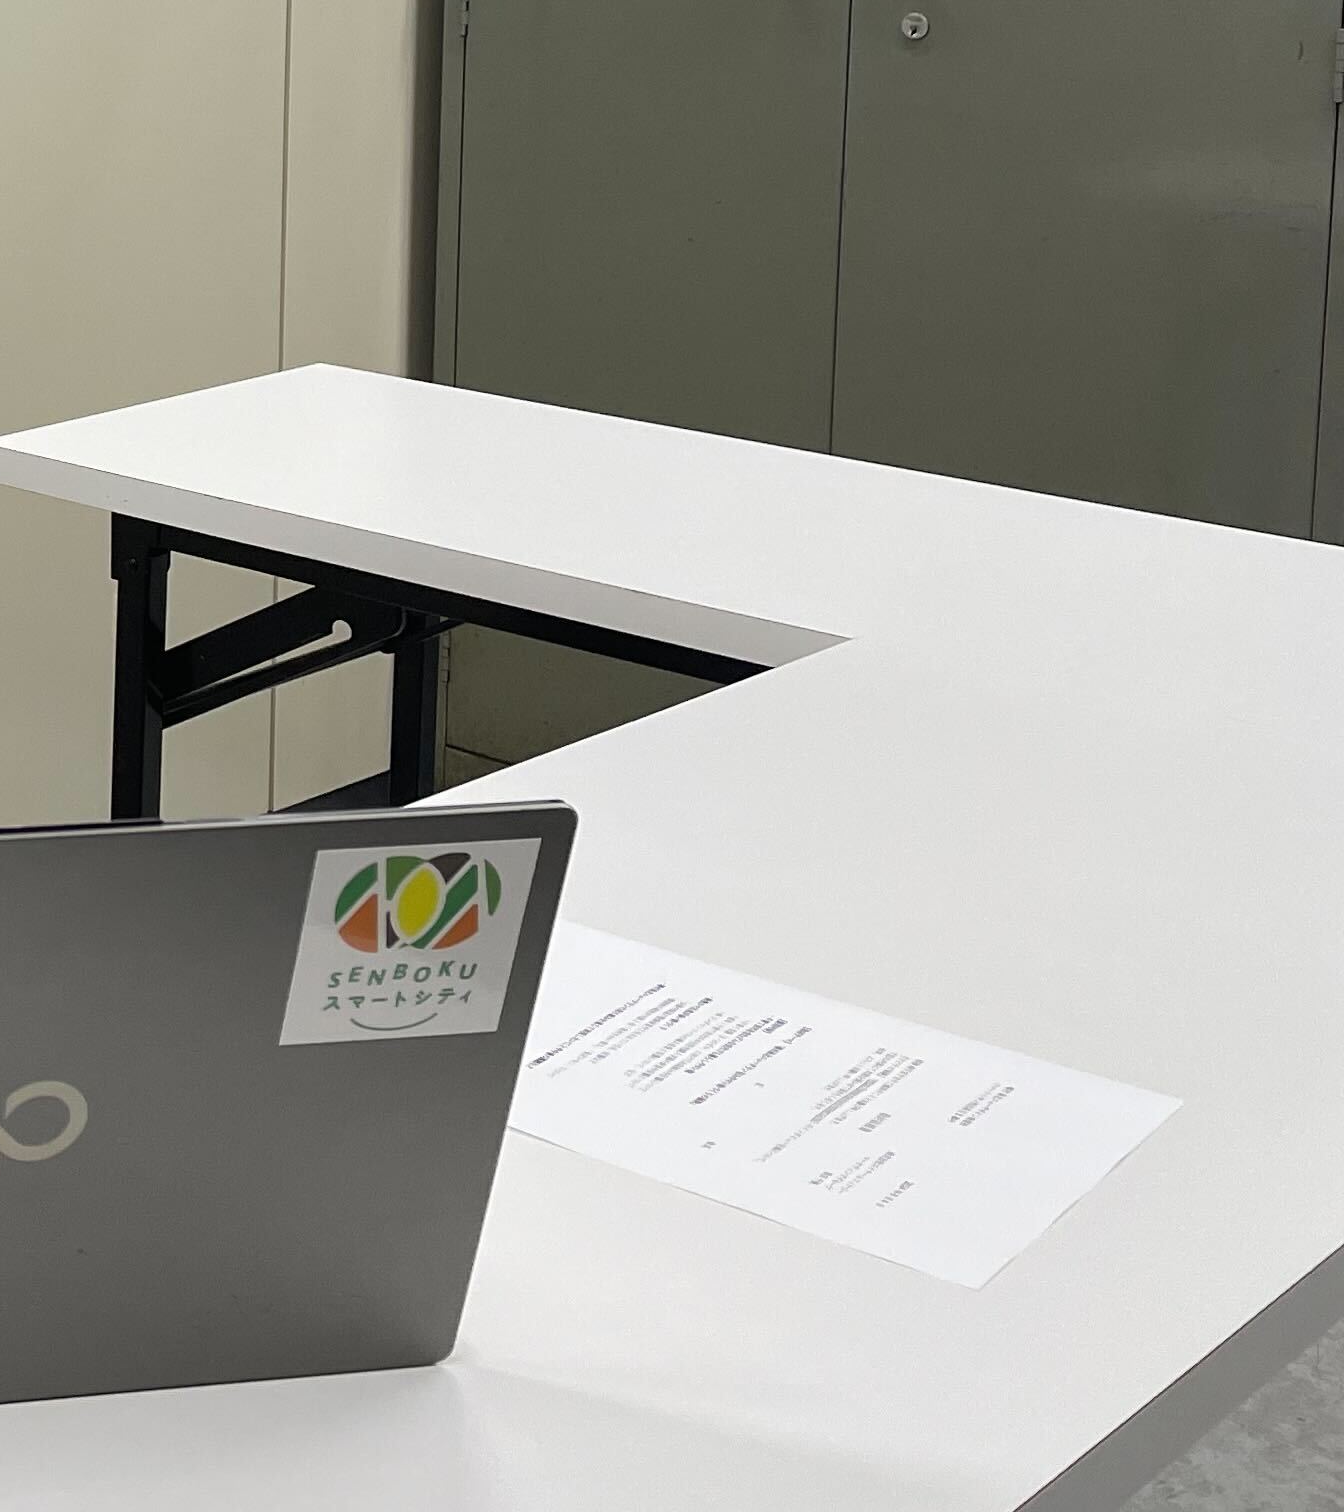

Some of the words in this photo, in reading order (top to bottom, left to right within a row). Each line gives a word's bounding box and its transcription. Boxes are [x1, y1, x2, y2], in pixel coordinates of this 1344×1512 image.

[327, 959, 479, 988] SENBOKU
[322, 988, 472, 1012] スマートシティ
